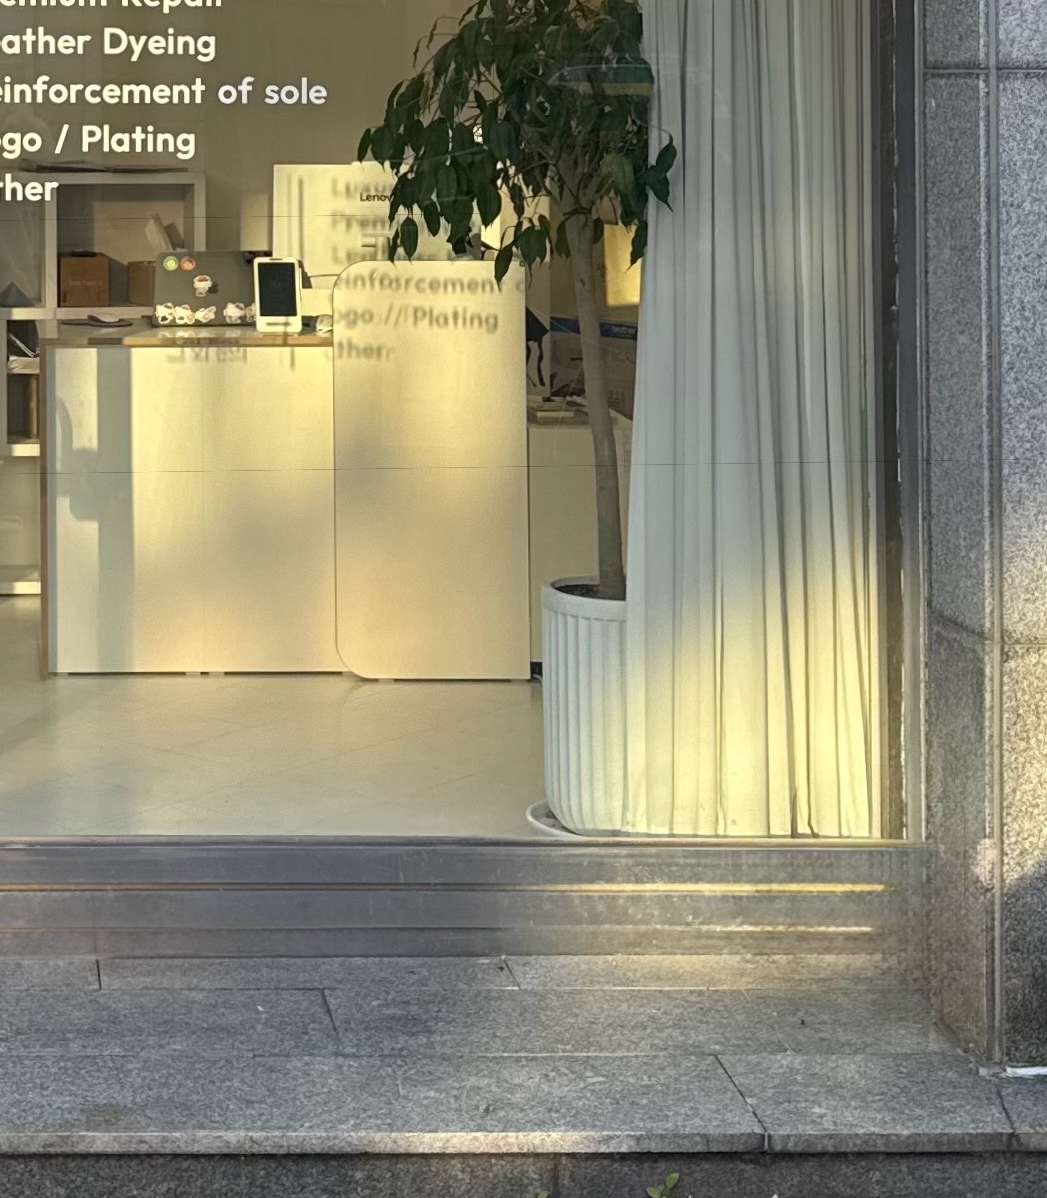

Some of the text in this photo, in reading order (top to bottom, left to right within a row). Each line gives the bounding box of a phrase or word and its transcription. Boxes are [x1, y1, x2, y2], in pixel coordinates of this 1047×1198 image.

[103, 27, 216, 63] Dyeing
[217, 76, 255, 105] of
[264, 77, 328, 105] sole
[54, 123, 70, 154] /
[81, 124, 196, 160] Plating
[360, 193, 393, 202] Lenov
